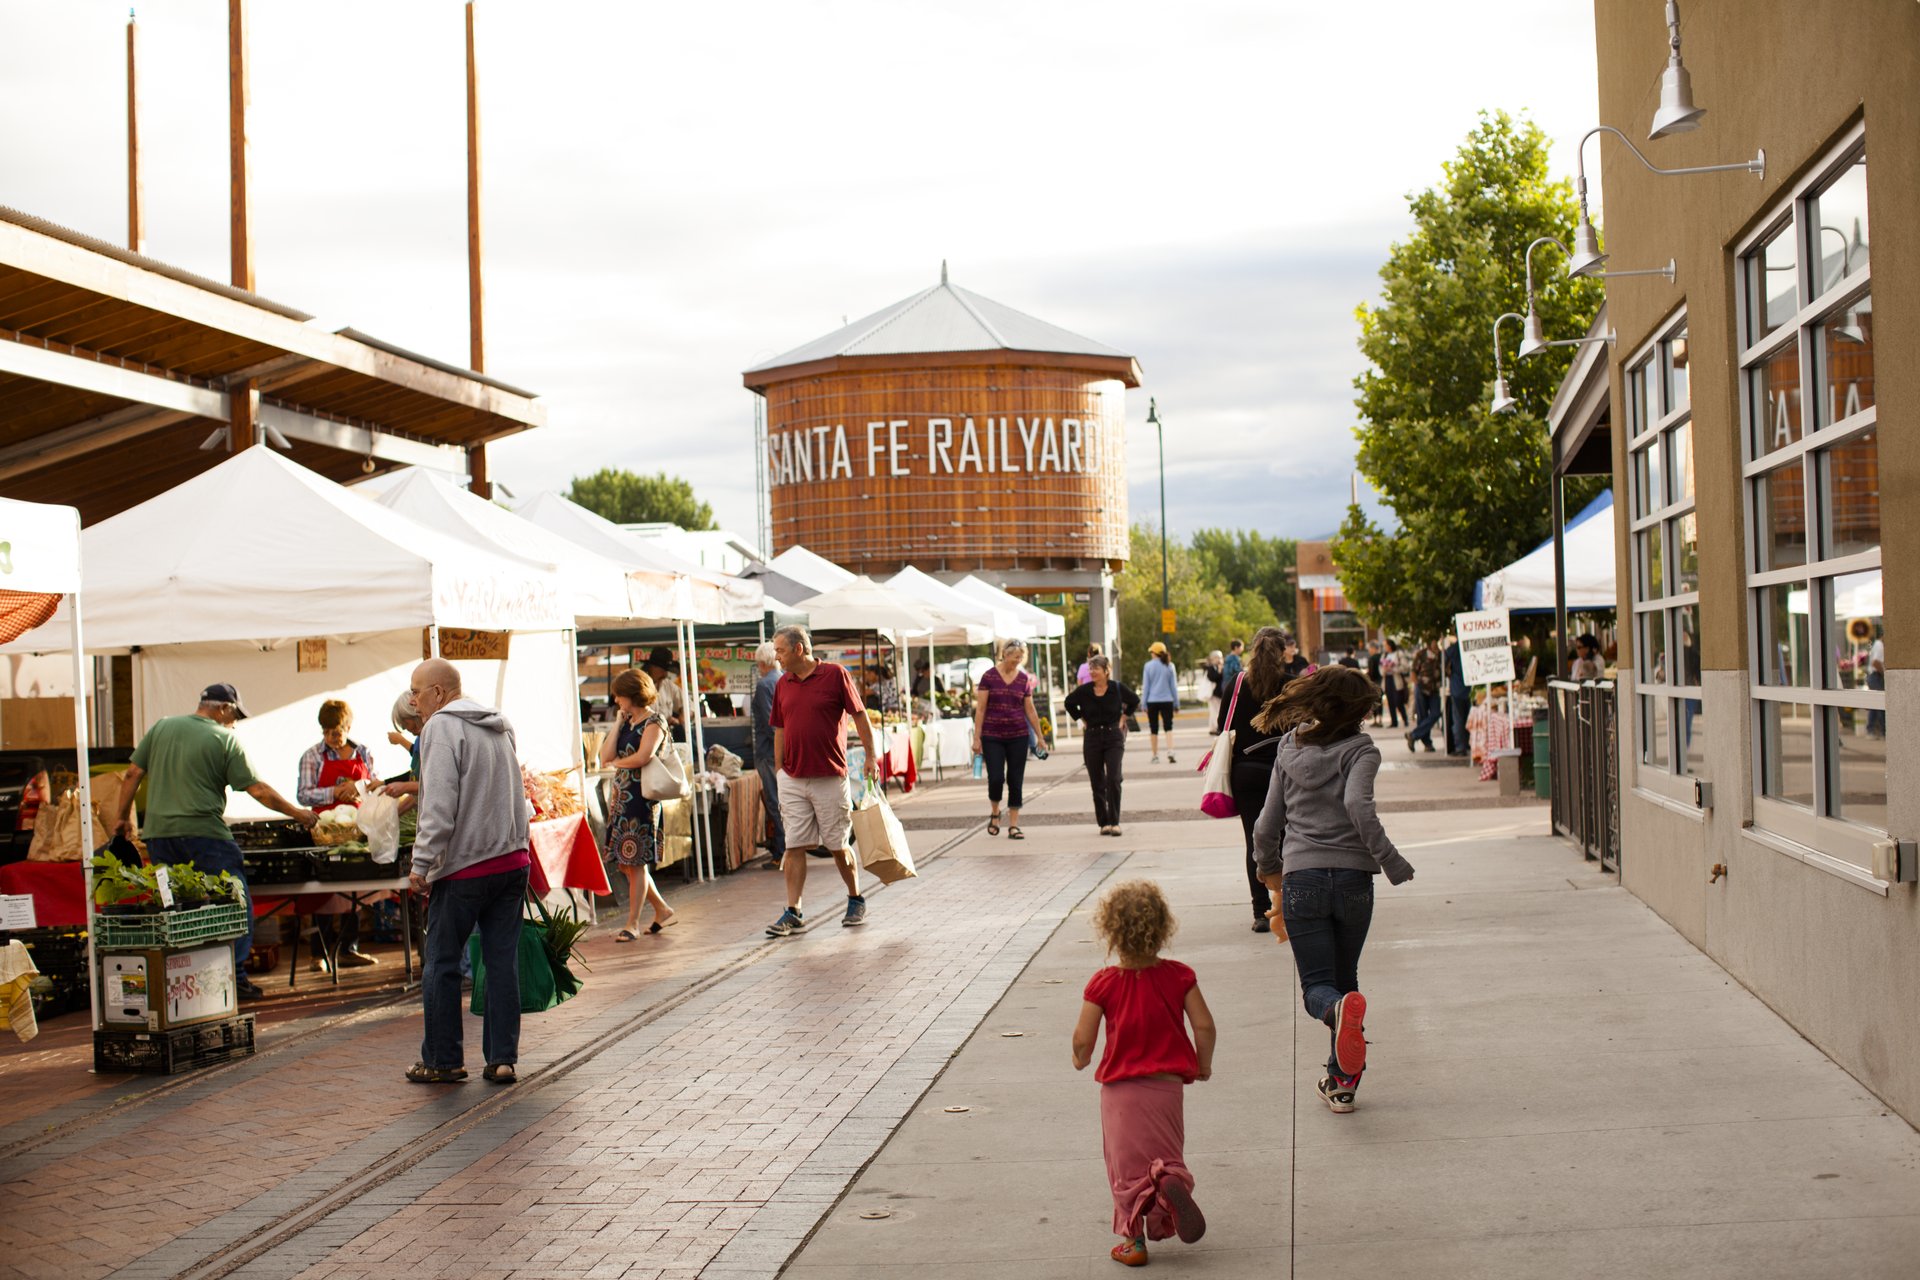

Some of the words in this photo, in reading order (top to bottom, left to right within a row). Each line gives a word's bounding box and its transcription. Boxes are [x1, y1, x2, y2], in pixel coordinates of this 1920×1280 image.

[769, 425, 853, 486] SANTA
[866, 420, 911, 477] FE
[928, 417, 1103, 474] RAILYARD
